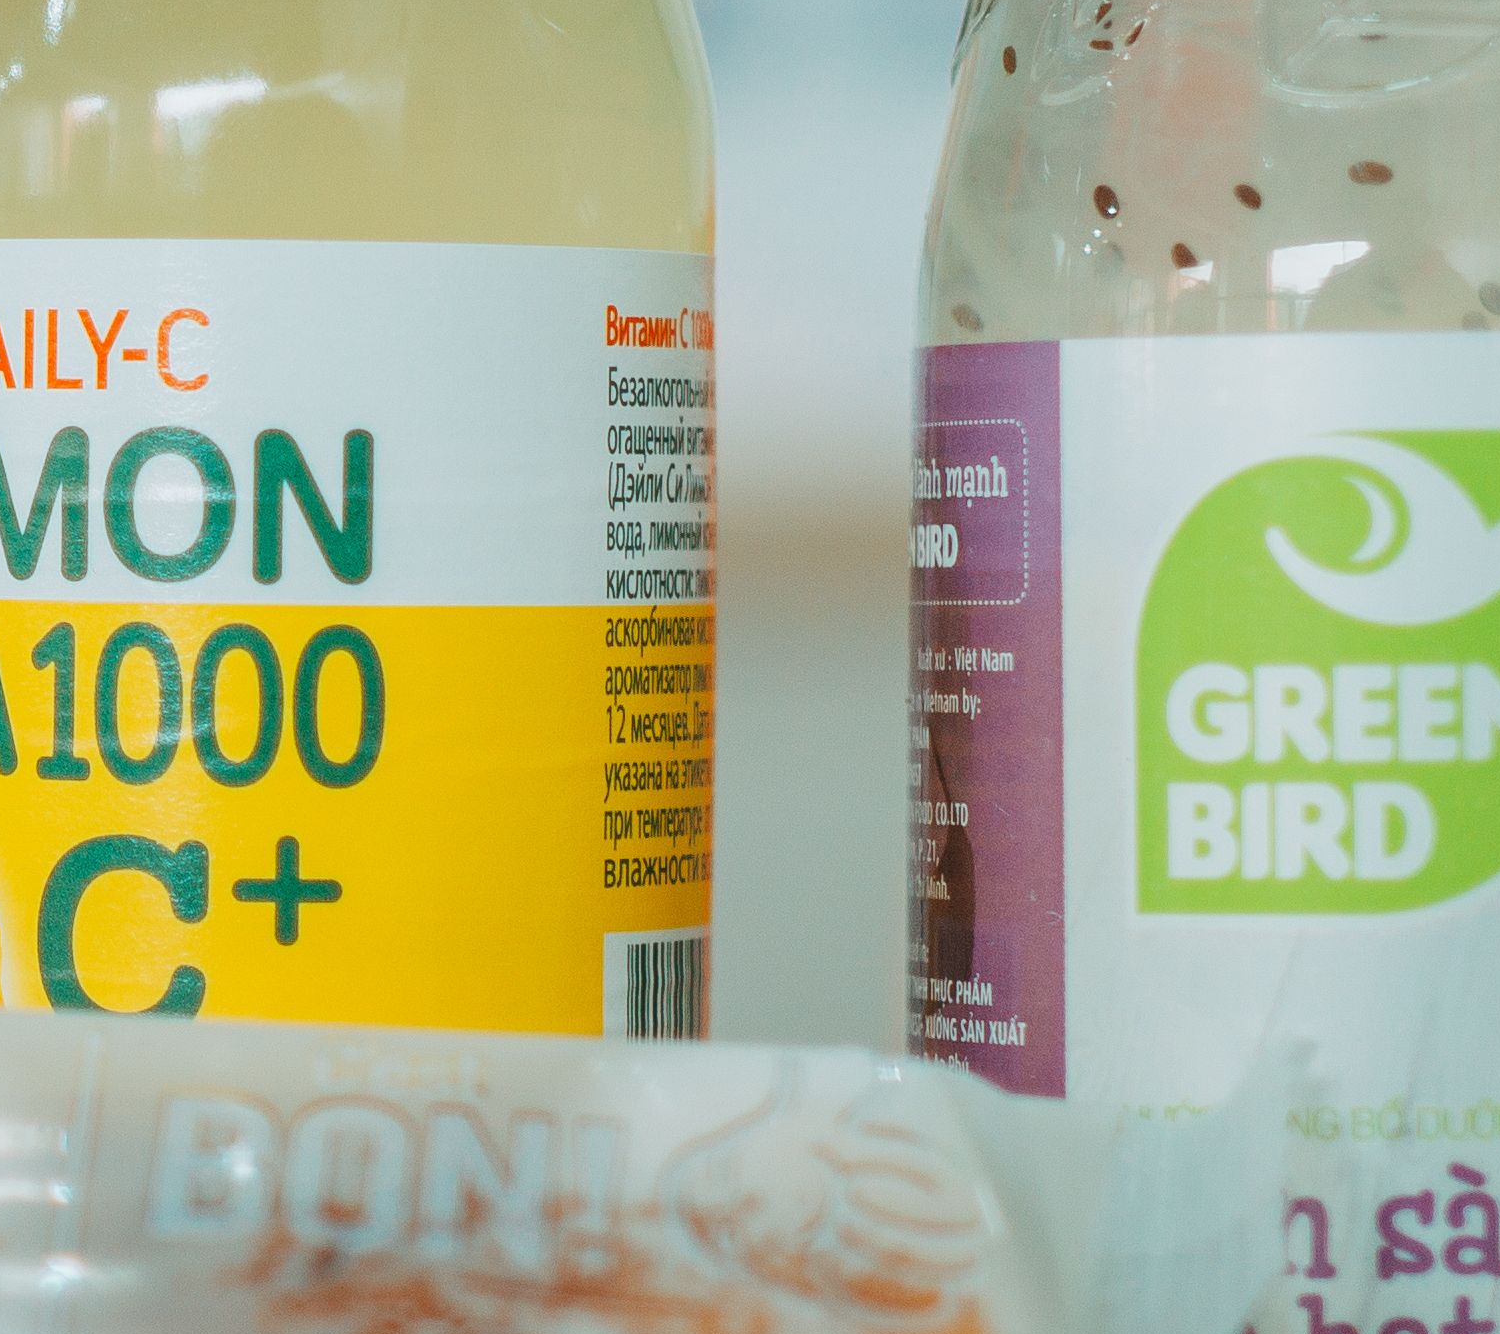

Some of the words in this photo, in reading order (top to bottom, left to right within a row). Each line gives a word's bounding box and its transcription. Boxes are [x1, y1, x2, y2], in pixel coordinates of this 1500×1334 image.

[605, 304, 677, 348] Витамин
[944, 454, 1009, 508] mạnh
[606, 521, 646, 559] вода,
[981, 646, 1014, 672] Nam
[31, 620, 386, 790] 1000
[606, 704, 626, 744] 12
[603, 760, 663, 803] указана
[665, 759, 679, 789] на
[603, 810, 633, 850] при
[1166, 780, 1437, 882] BIRD
